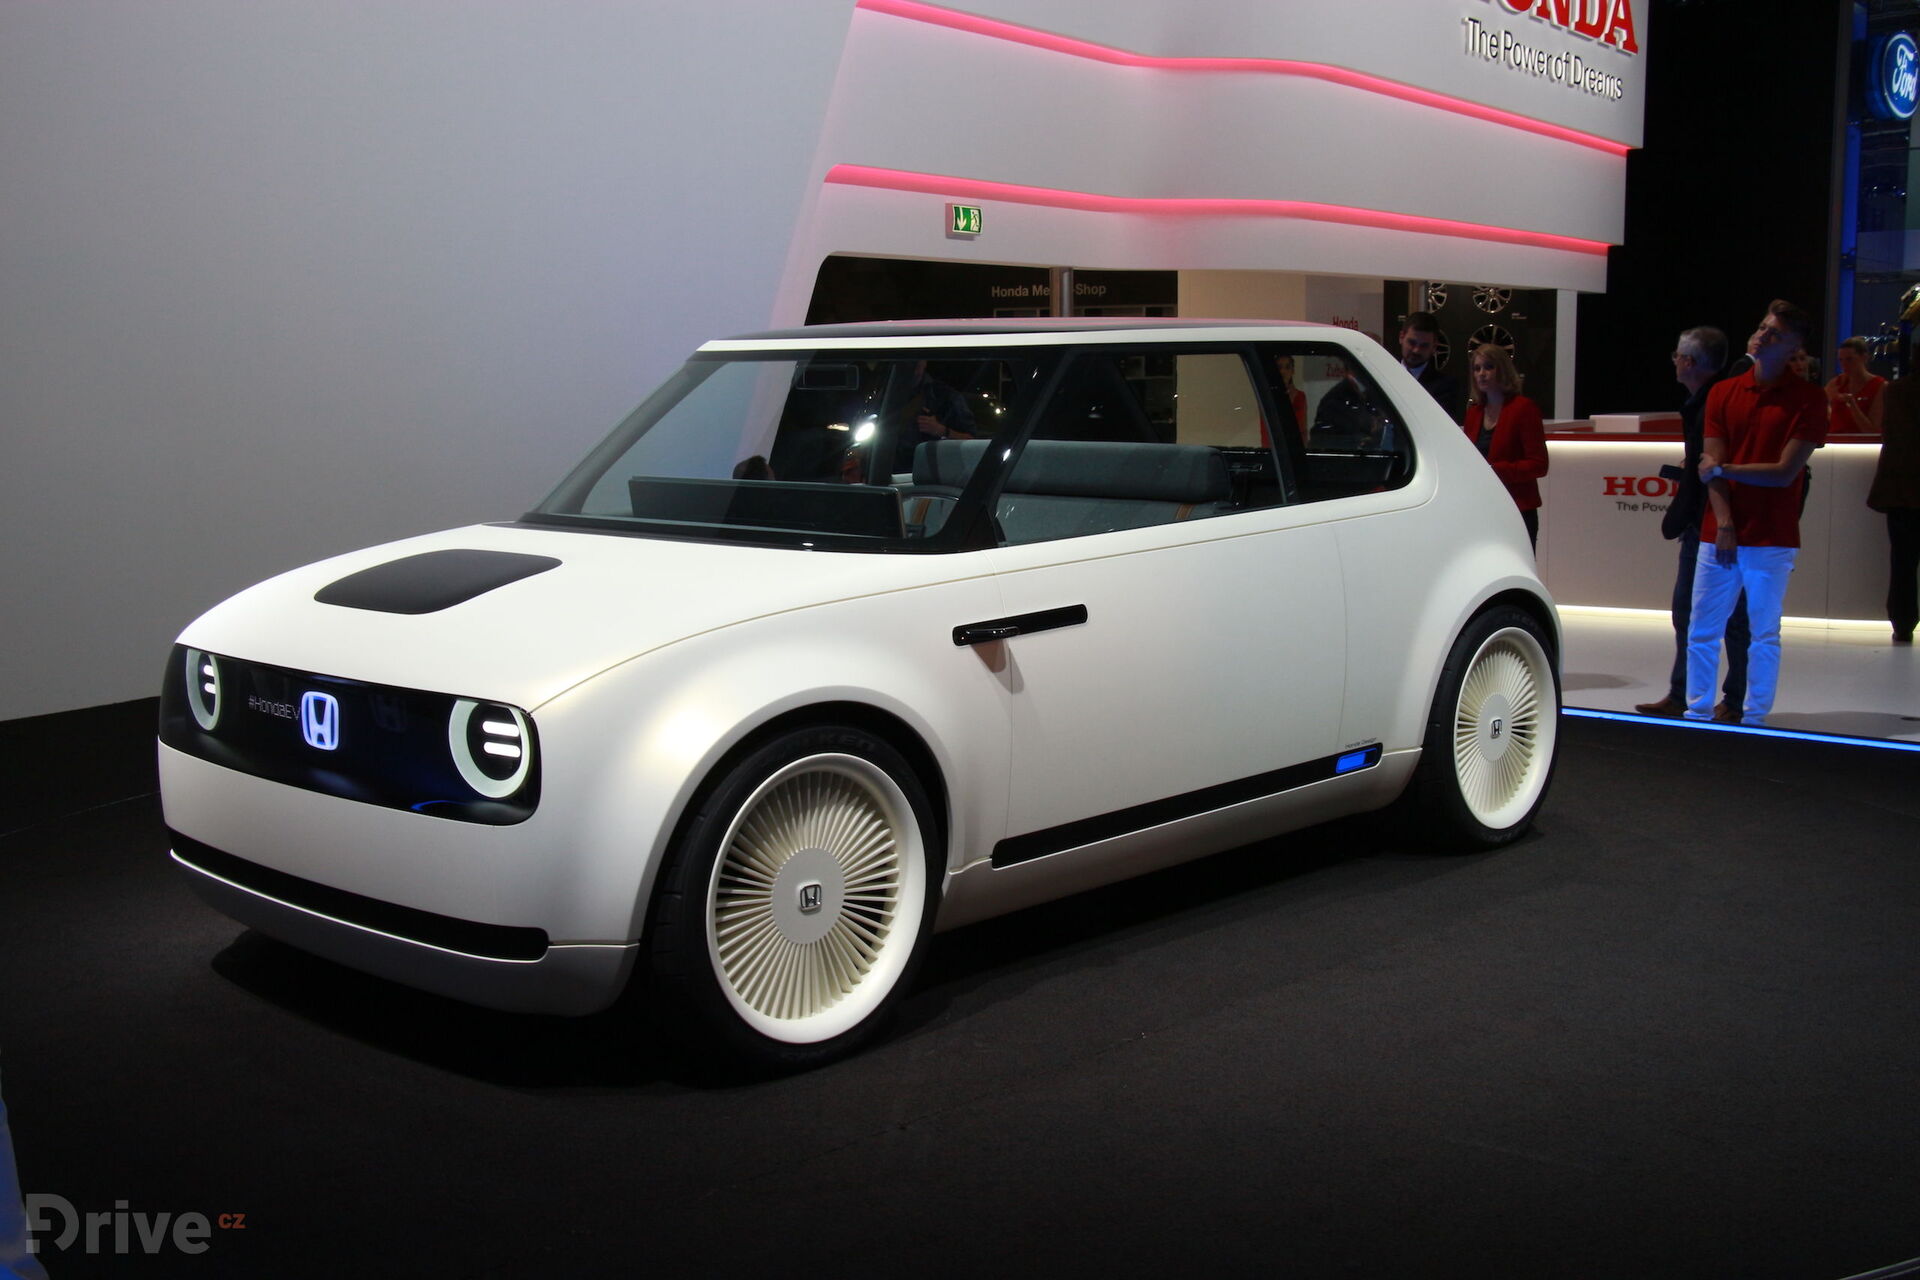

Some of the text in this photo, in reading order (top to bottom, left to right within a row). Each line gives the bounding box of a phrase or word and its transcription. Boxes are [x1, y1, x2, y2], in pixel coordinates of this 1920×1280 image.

[1464, 17, 1624, 100] The Power of Dreams
[1892, 44, 1919, 102] Ford
[991, 285, 1029, 297] Honda
[1332, 315, 1359, 331] Honda
[1616, 501, 1639, 511] The
